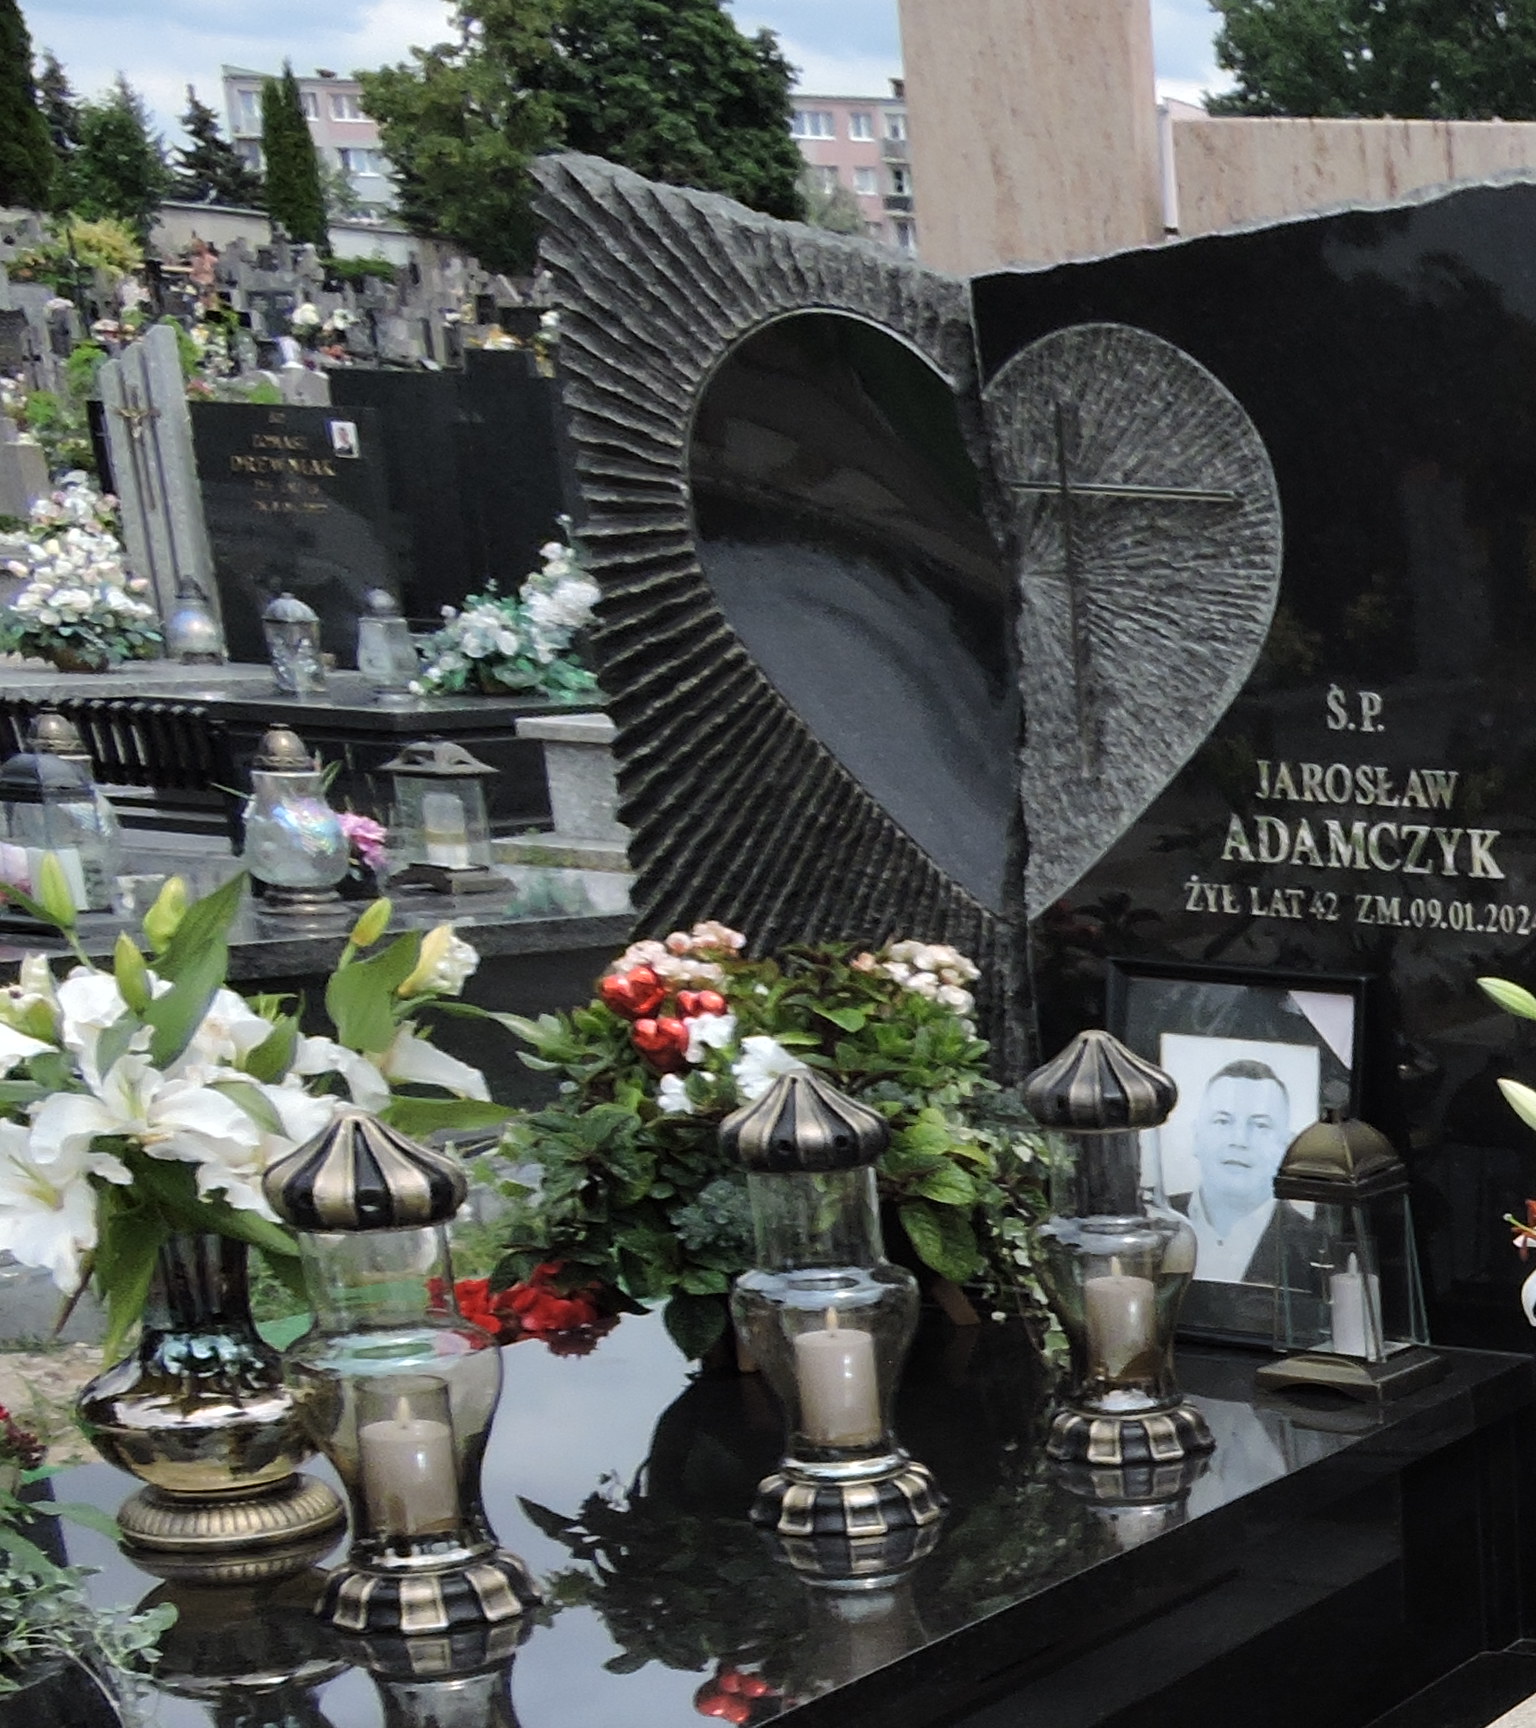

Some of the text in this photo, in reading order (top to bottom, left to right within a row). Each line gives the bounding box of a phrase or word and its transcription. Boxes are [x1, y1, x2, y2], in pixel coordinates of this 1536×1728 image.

[1326, 684, 1385, 732] Ś.P.
[1255, 760, 1459, 810] JAROSŁAW
[1221, 813, 1505, 880] ADAMCZYK
[1184, 875, 1241, 913] ŻYŁ
[1250, 887, 1305, 918] LAT
[1309, 891, 1341, 922] 42
